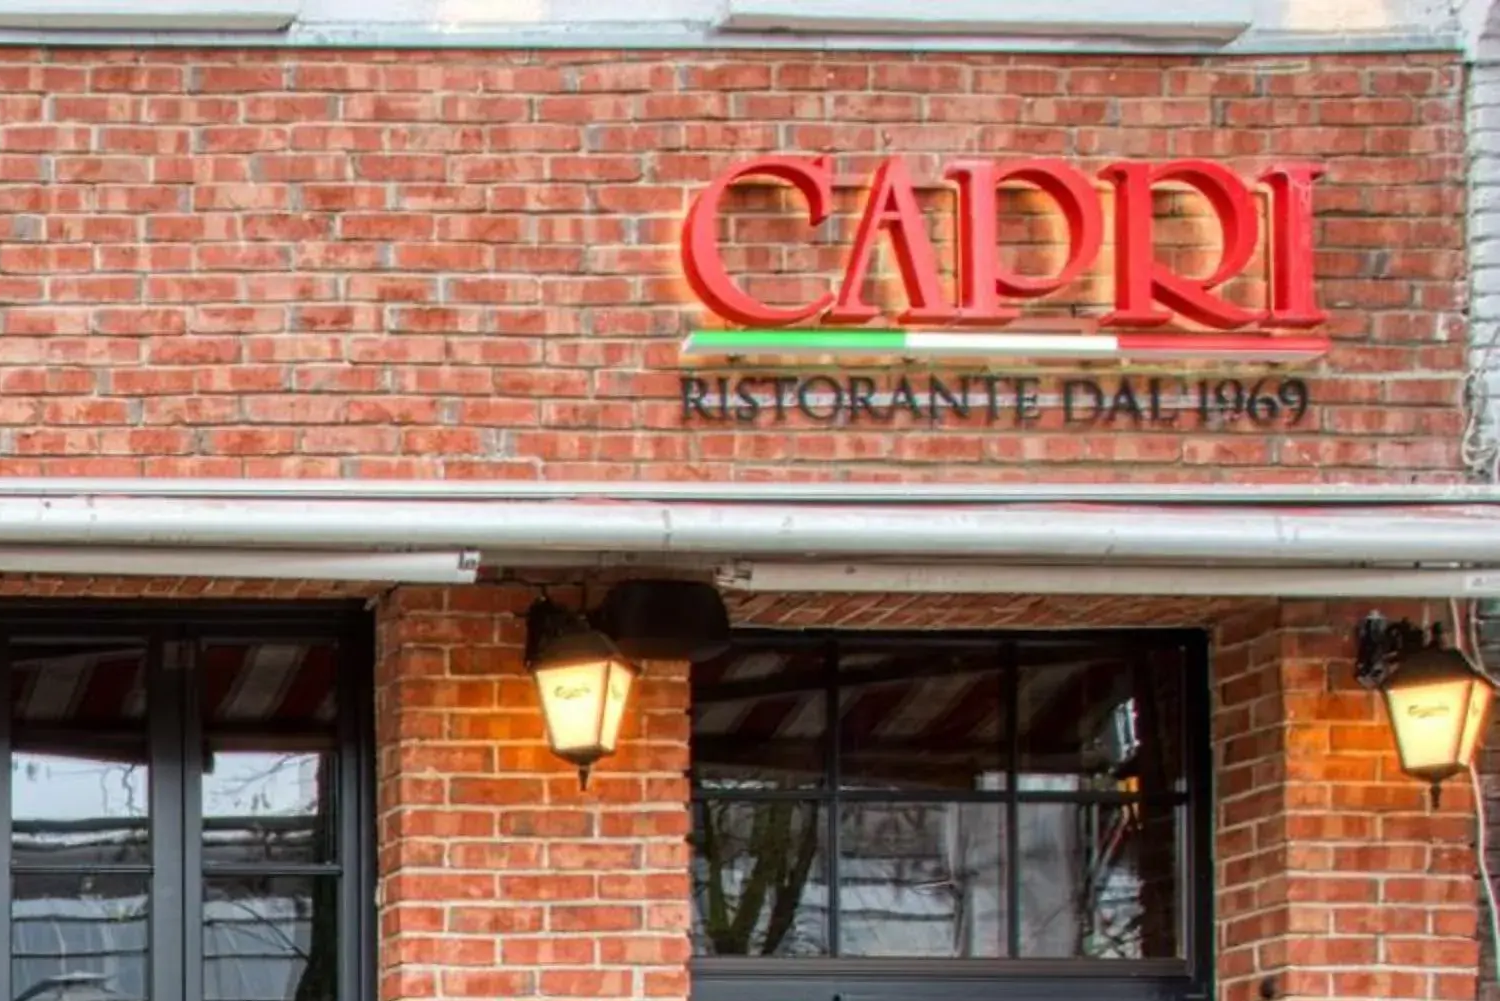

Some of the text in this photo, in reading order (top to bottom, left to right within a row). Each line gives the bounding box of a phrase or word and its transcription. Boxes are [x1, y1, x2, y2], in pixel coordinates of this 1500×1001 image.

[680, 153, 1326, 331] CAPRI
[680, 374, 1043, 424] RISTORANTE
[1196, 376, 1310, 428] 1969
